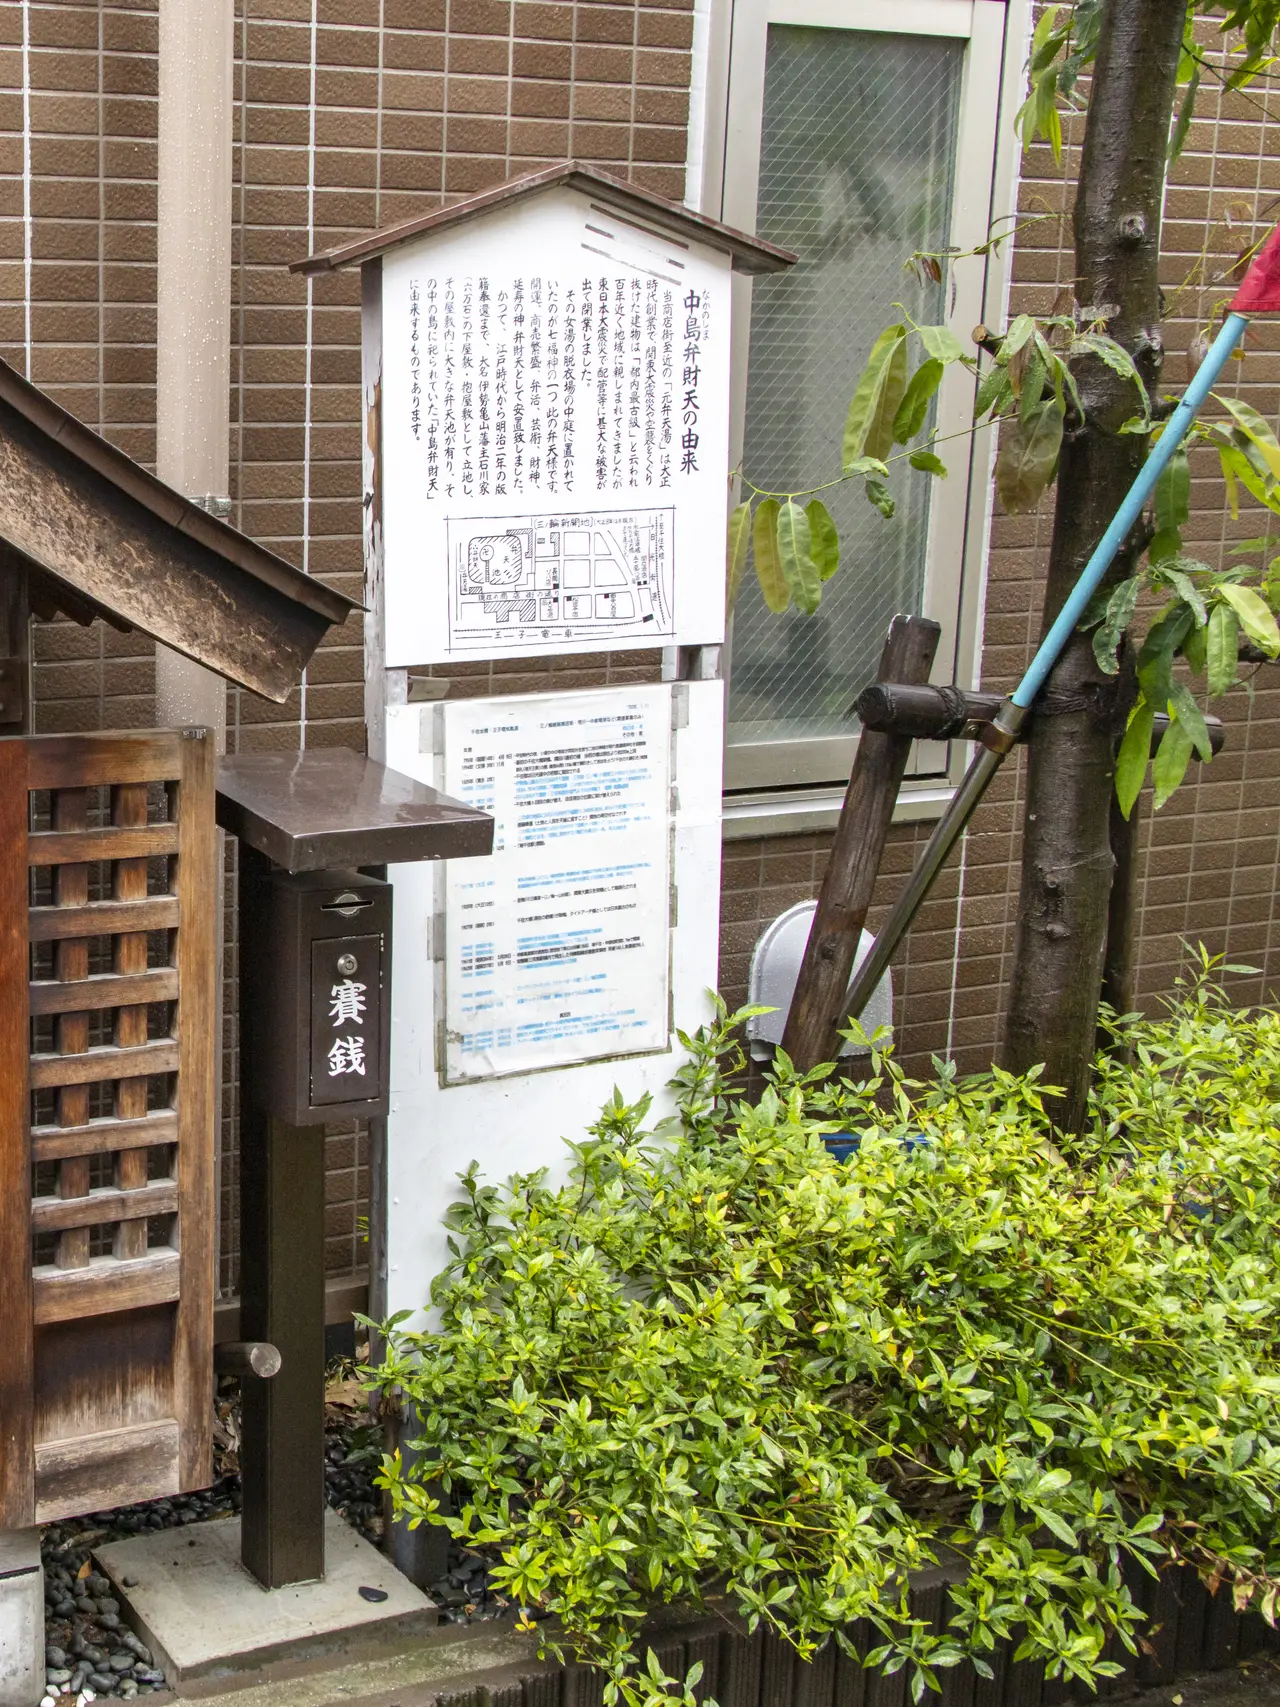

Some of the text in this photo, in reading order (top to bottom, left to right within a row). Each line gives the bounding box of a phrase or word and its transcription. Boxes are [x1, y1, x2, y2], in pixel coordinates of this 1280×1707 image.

[409, 279, 422, 441] に由来するものであります。
[563, 290, 576, 492] その女湯の脱衣場の中庭に置かれて
[581, 278, 592, 387] 出て閉業しました。
[596, 277, 609, 490] 東日本大震災で配管等に甚大な被害が
[612, 278, 625, 490] 百年近く地域に親しまれてきましたが
[628, 278, 641, 488] 抜けた建物は「都内最古級」と云われ
[659, 290, 674, 488] 当商店街至近の「元弁天湯」は大正
[680, 289, 701, 475] 中島弁財天の由来
[701, 289, 710, 341] なかのしま
[328, 979, 367, 1076] 賽銭
